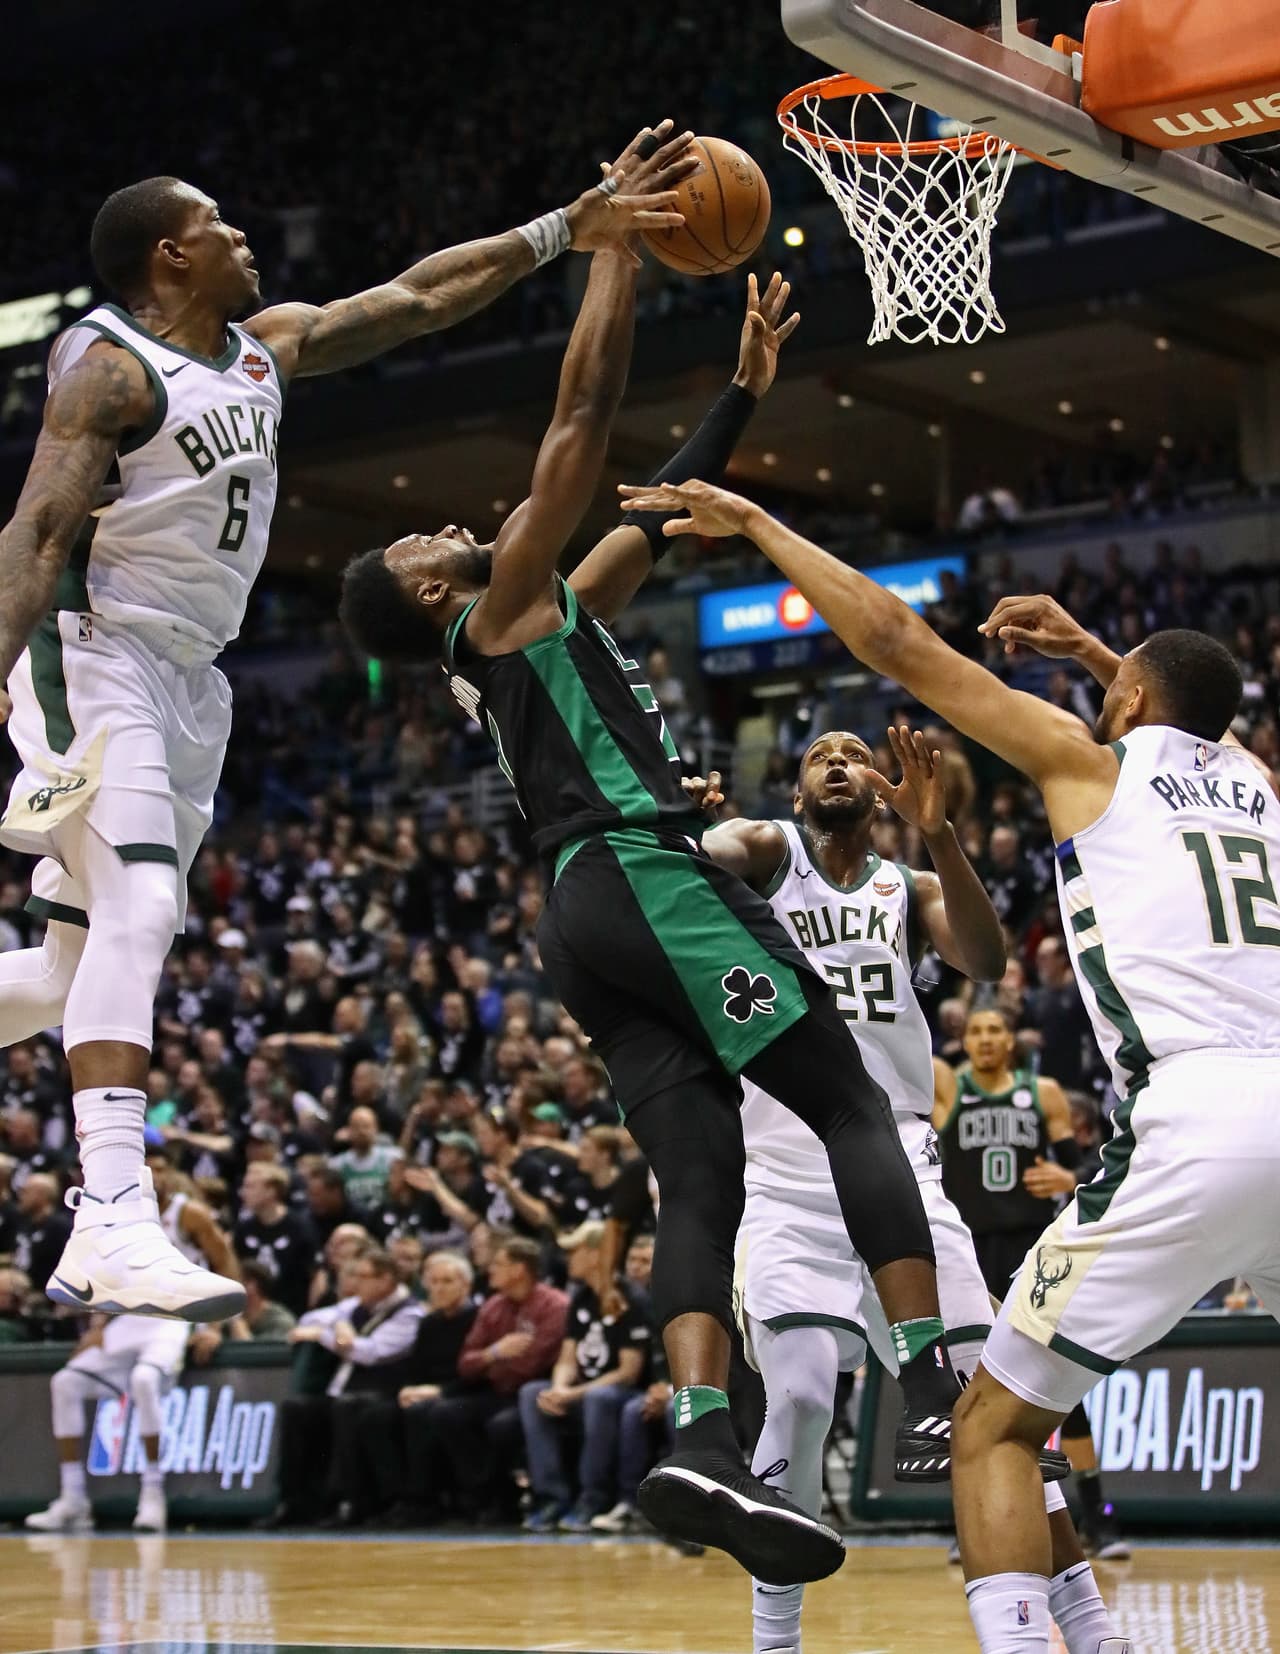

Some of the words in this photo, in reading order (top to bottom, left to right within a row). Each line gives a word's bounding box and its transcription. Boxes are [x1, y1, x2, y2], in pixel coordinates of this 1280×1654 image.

[217, 475, 250, 552] 6
[1150, 773, 1266, 826] PARKER
[1179, 829, 1280, 949] 12
[822, 961, 897, 1024] 22
[958, 1106, 1040, 1151] CELTICS
[982, 1147, 1018, 1192] 0
[202, 1384, 276, 1490] App
[1172, 1367, 1265, 1491] App
